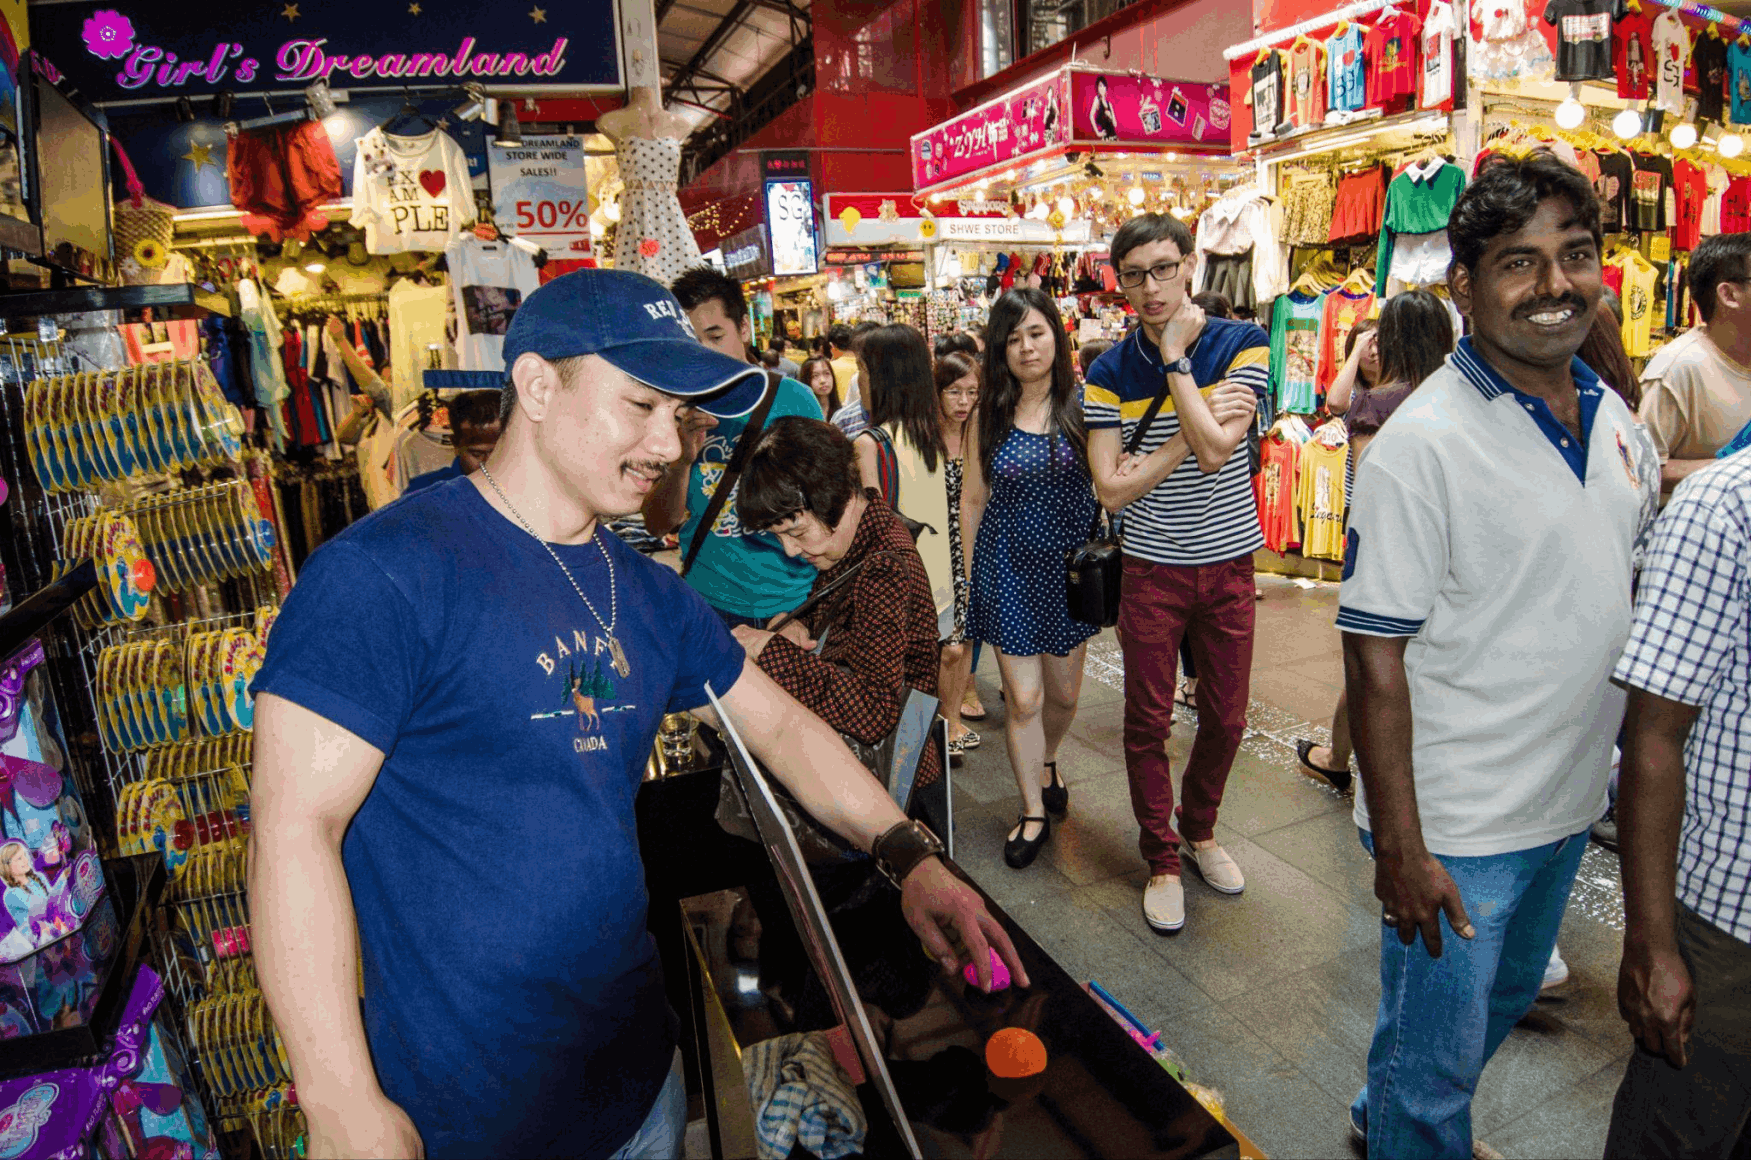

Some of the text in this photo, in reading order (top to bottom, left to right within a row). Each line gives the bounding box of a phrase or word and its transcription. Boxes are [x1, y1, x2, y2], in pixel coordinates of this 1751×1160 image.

[116, 43, 260, 89] Girl's
[274, 37, 568, 80] Dreamland
[521, 140, 580, 148] DREAMLAND
[505, 151, 567, 160] STORE WIDE
[520, 167, 557, 176] SALES!!
[389, 187, 419, 202] AM
[515, 200, 588, 229] 50%
[778, 194, 803, 220] SG
[391, 205, 449, 234] PLE
[949, 223, 1019, 235] SHWE STORE
